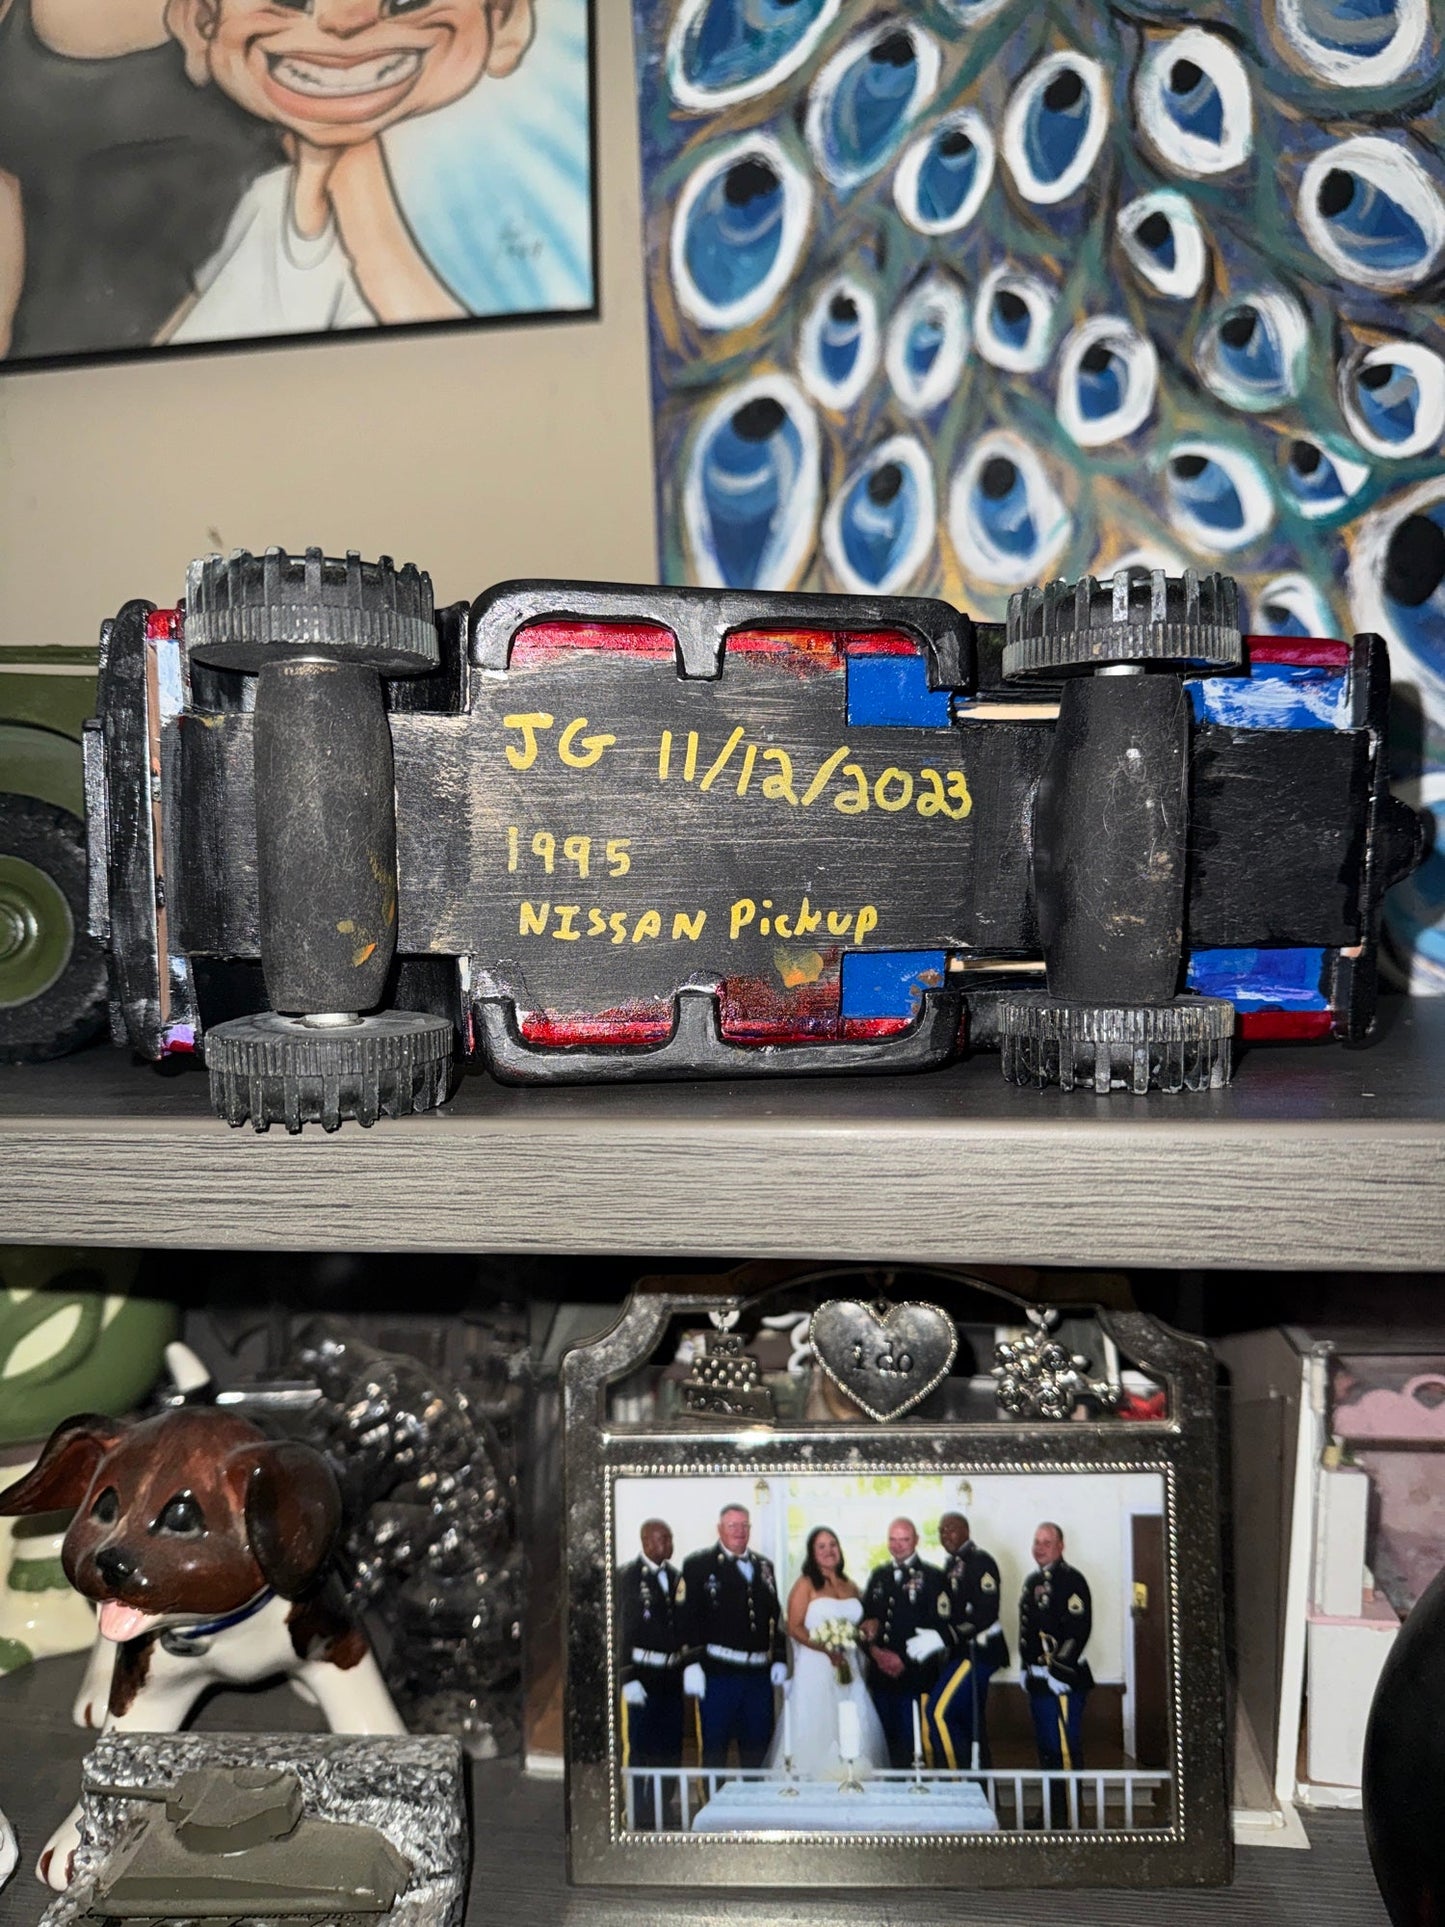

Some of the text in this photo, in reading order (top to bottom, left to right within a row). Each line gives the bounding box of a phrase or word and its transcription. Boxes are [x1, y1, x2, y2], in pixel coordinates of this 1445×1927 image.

[658, 726, 974, 820] 11/12/2023
[507, 826, 632, 879] 1995
[518, 901, 708, 944] NISSAN
[876, 1340, 914, 1376] do
